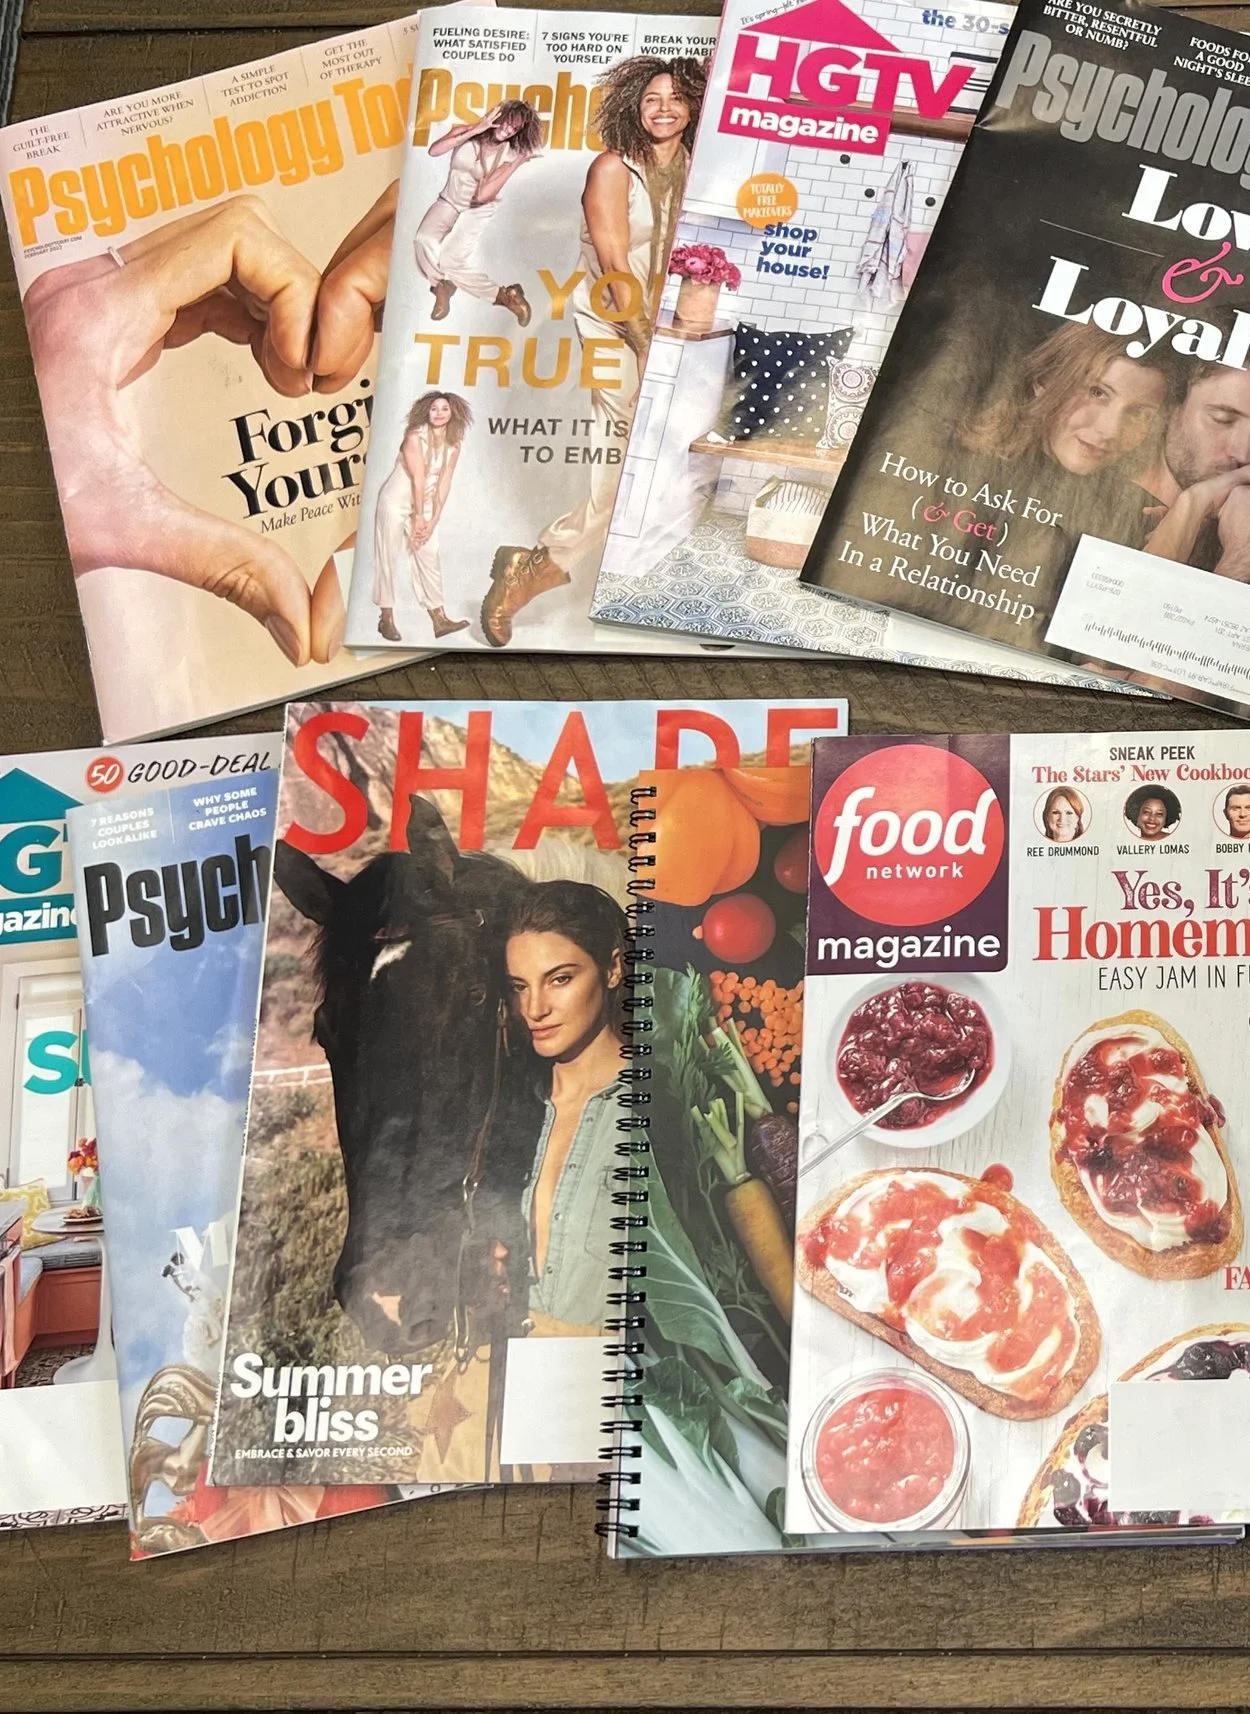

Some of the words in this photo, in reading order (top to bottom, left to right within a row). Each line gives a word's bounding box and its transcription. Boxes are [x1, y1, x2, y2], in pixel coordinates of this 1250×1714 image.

[922, 9, 957, 29] the
[433, 28, 480, 37] FUELING
[483, 29, 530, 40] DESIRE:
[644, 35, 682, 44] BREAK
[686, 37, 716, 45] YOUR
[324, 45, 343, 56] GET
[345, 39, 367, 52] THE
[434, 39, 465, 48] WHAT
[468, 40, 526, 51] SATISFIED
[641, 47, 682, 55] WORRY
[1190, 37, 1231, 56] FOODS
[322, 54, 351, 69] MOST
[353, 48, 374, 61] OUT
[442, 51, 496, 60] COUPLES
[499, 53, 514, 62] DO
[1196, 51, 1203, 61] A
[1207, 55, 1244, 72] GOOD
[320, 71, 335, 80] OF
[337, 57, 382, 76] THERAPY
[727, 34, 976, 120] HGTV
[1174, 56, 1222, 79] NIGHT'S
[103, 107, 123, 119] ARE
[126, 100, 148, 113] YOU
[150, 91, 182, 107] MORE
[96, 110, 160, 132] ATTRACTIVE
[161, 99, 194, 115] WHEN
[730, 107, 879, 144] magazine
[29, 124, 49, 137] THE
[121, 116, 174, 136] NERVOUS?
[12, 131, 71, 153] GUILT-FREE
[26, 145, 61, 160] BREAK
[9, 98, 344, 246] Psychology
[751, 184, 784, 194] TOTALLY
[758, 196, 776, 206] FREE
[743, 206, 792, 218] MAKEOVERS
[764, 222, 818, 242] shop
[760, 241, 812, 259] your
[756, 258, 830, 280] house!
[1162, 241, 1244, 303] &
[414, 333, 626, 390] TRUE
[488, 417, 562, 436] WHAT
[571, 419, 600, 437] IT
[605, 420, 629, 438] IS
[522, 446, 553, 464] TO
[879, 452, 940, 488] How
[944, 477, 967, 497] to
[972, 484, 1017, 514] Ask
[1021, 497, 1062, 527] For
[260, 511, 298, 534] Make
[300, 500, 334, 526] Peace
[863, 512, 923, 551] What
[929, 533, 968, 566] You
[976, 550, 1041, 588] Need
[838, 540, 863, 568] In
[870, 557, 882, 573] a
[888, 555, 1035, 625] Relationship
[90, 764, 119, 786] 50
[127, 751, 271, 783] GOOD-DEAL
[1032, 766, 1068, 783] The
[1131, 765, 1169, 781] New
[193, 794, 221, 807] WHY
[224, 787, 258, 802] SOME
[205, 800, 249, 816] PEOPLE
[189, 818, 225, 831] CRAVE
[228, 808, 267, 824] CHAOS
[823, 786, 997, 887] food
[1027, 846, 1045, 857] REE
[1048, 845, 1099, 856] DRUMMOND
[1117, 844, 1156, 855] VALLERY
[1159, 843, 1190, 854] LOMAS
[1216, 843, 1244, 853] BOBBY
[866, 862, 963, 879] network
[1112, 870, 1194, 917] Yes,
[817, 925, 1000, 968] magazine
[230, 1353, 433, 1398] Summer
[273, 1396, 379, 1443] bliss
[235, 1450, 284, 1459] EMBRACE
[287, 1450, 293, 1458] &
[296, 1448, 330, 1458] SAVOR
[333, 1448, 364, 1457] EVERY
[368, 1447, 412, 1457] SECOND
